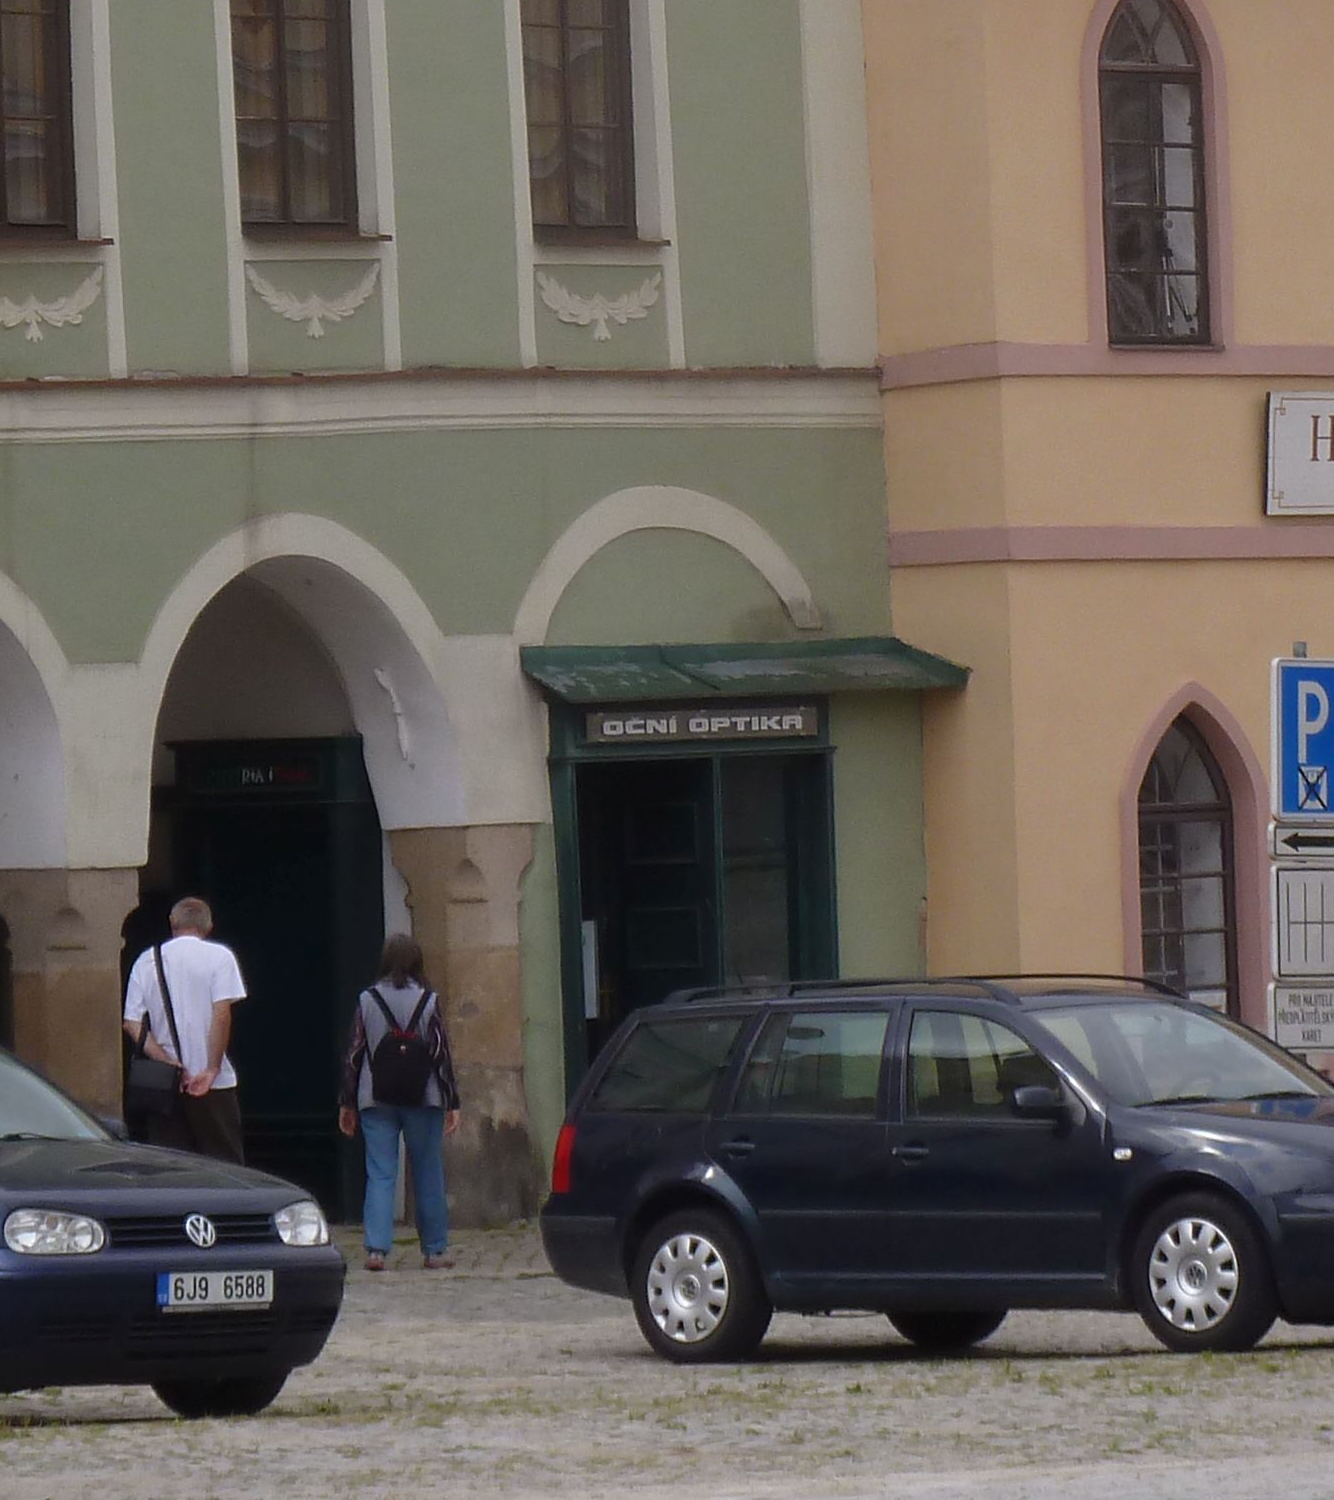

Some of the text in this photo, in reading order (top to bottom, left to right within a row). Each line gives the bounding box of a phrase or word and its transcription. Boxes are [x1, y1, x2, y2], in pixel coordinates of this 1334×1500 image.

[602, 715, 803, 736] OČNÍ OPTIKA
[1297, 680, 1329, 764] P
[174, 1276, 209, 1301] 6J9
[223, 1275, 265, 1299] 6588
